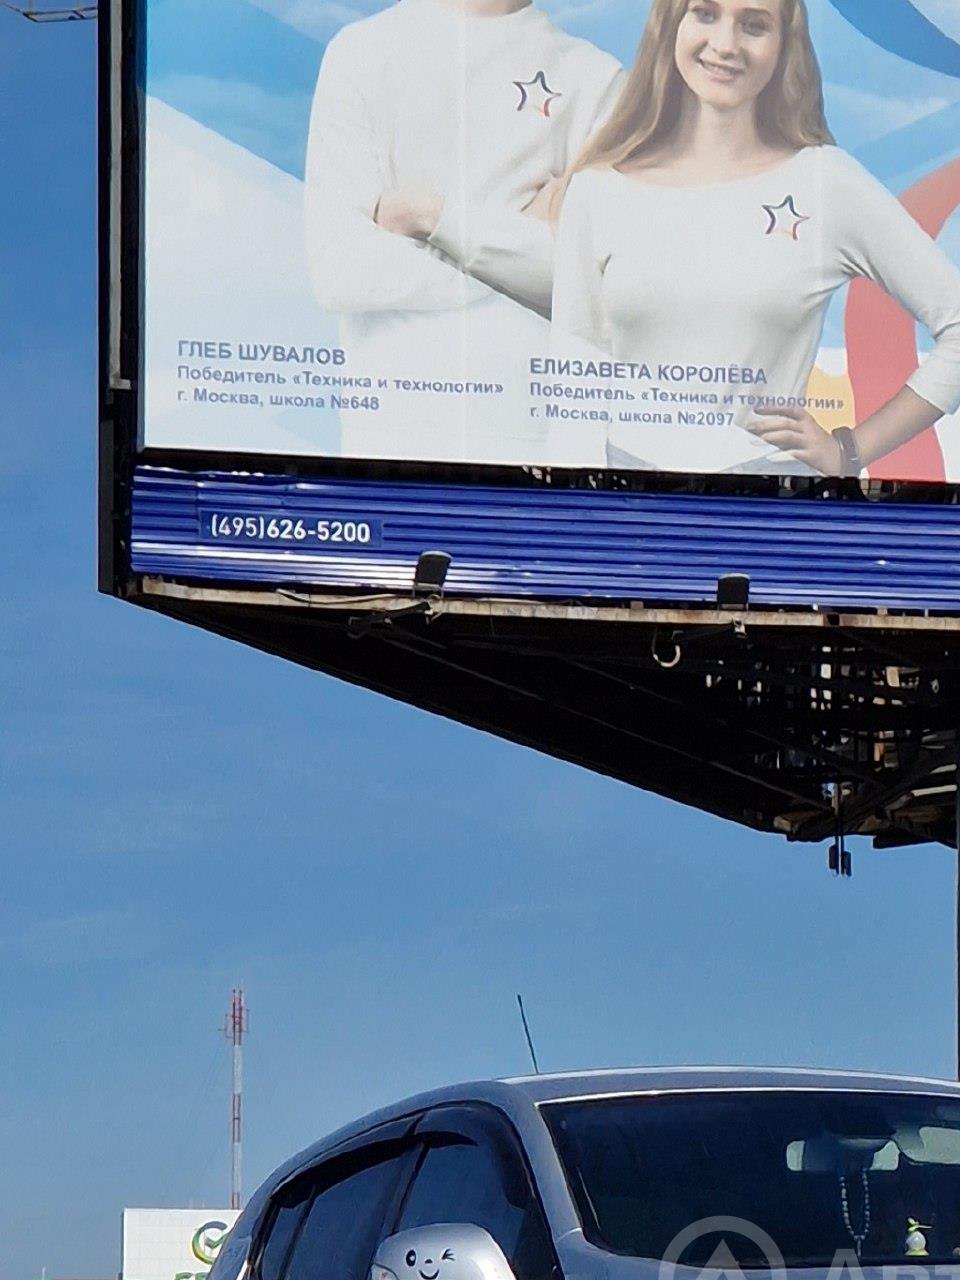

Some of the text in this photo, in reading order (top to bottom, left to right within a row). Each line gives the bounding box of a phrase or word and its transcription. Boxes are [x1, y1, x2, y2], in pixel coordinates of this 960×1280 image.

[177, 340, 346, 365] ГЛЕБ ШУВАЛОВ
[177, 366, 504, 395] Победитель «Техника и технологии»
[530, 358, 650, 380] ЕЛИЗАВЕТА
[177, 389, 380, 410] г. Москва, школа №648
[530, 382, 845, 410] Победитель «Техника и технологии»
[530, 404, 734, 427] г. Москва, школа №2097
[211, 514, 371, 543] (495)626-5200
